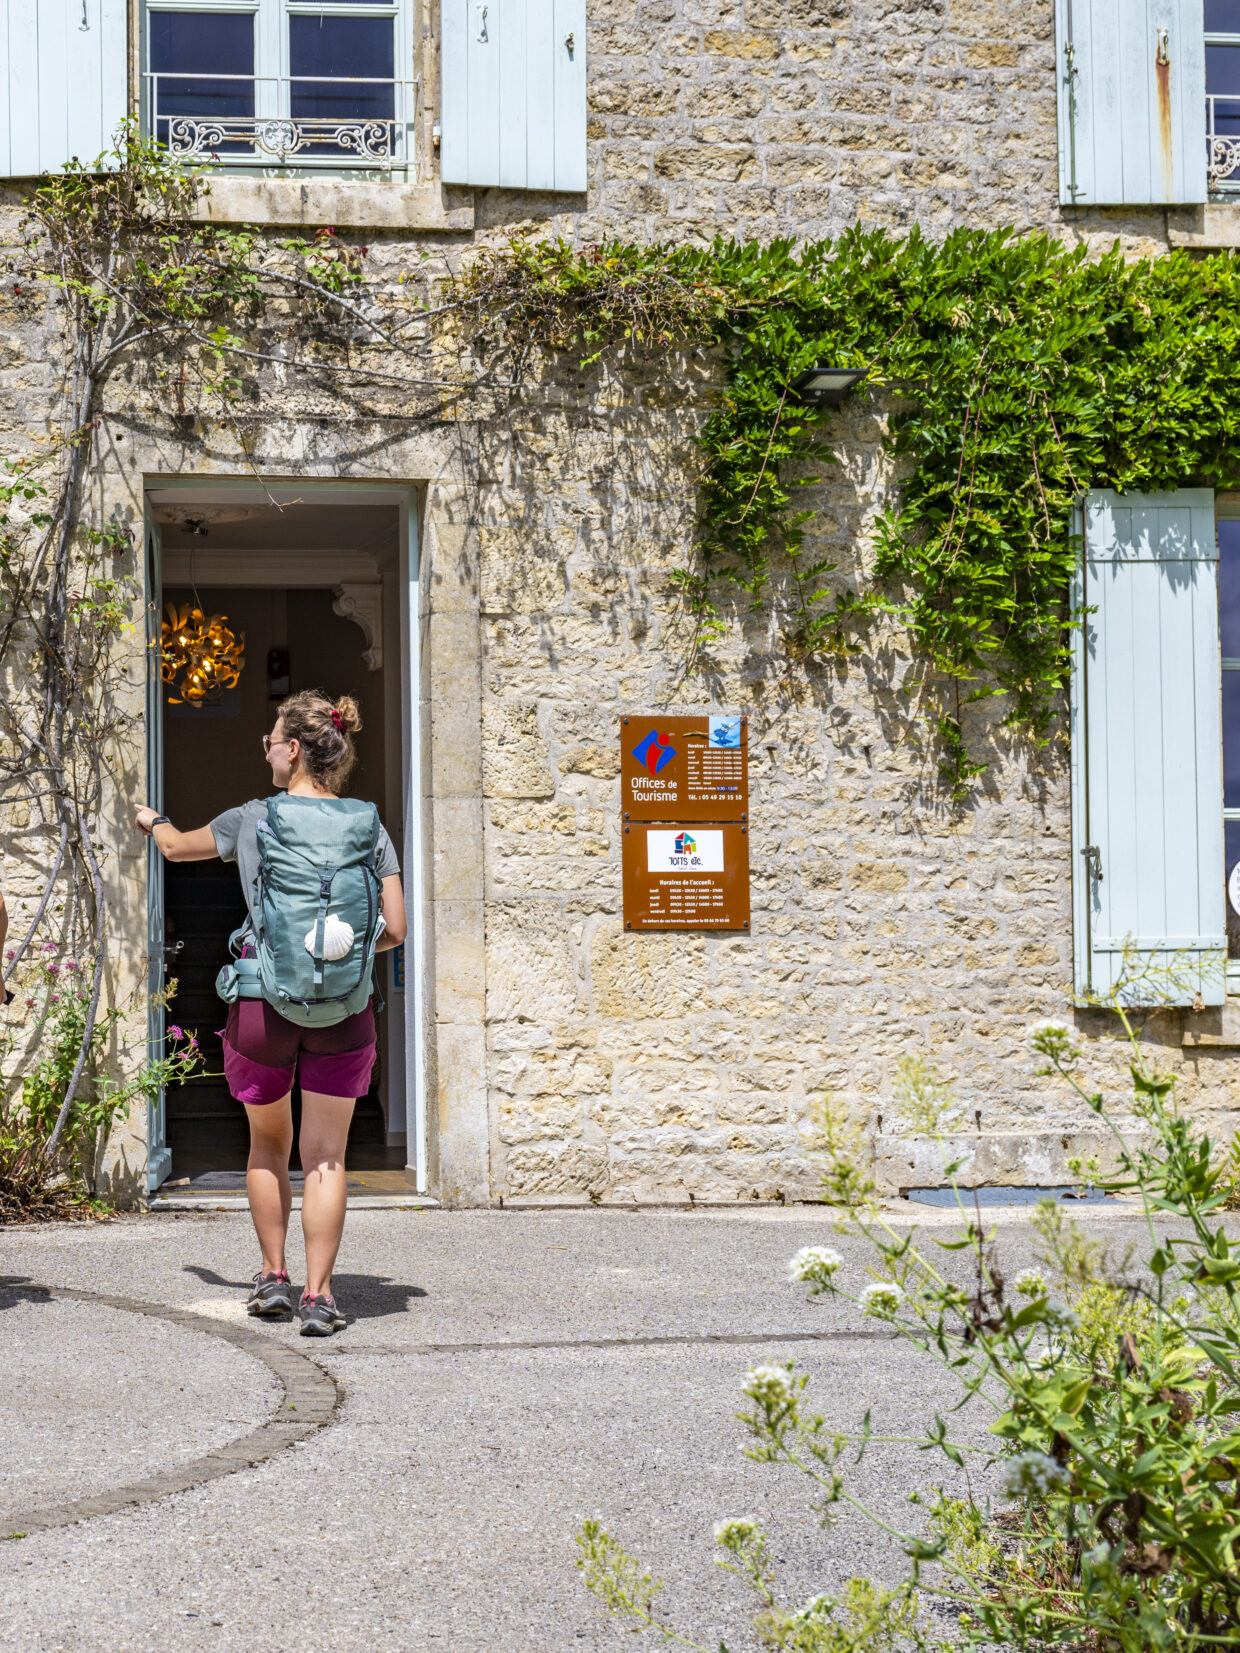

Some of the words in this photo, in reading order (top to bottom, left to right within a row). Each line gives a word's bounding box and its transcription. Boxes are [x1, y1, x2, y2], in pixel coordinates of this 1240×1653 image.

[631, 777, 665, 788] Offices
[668, 780, 677, 788] de
[631, 790, 677, 801] Tourisme
